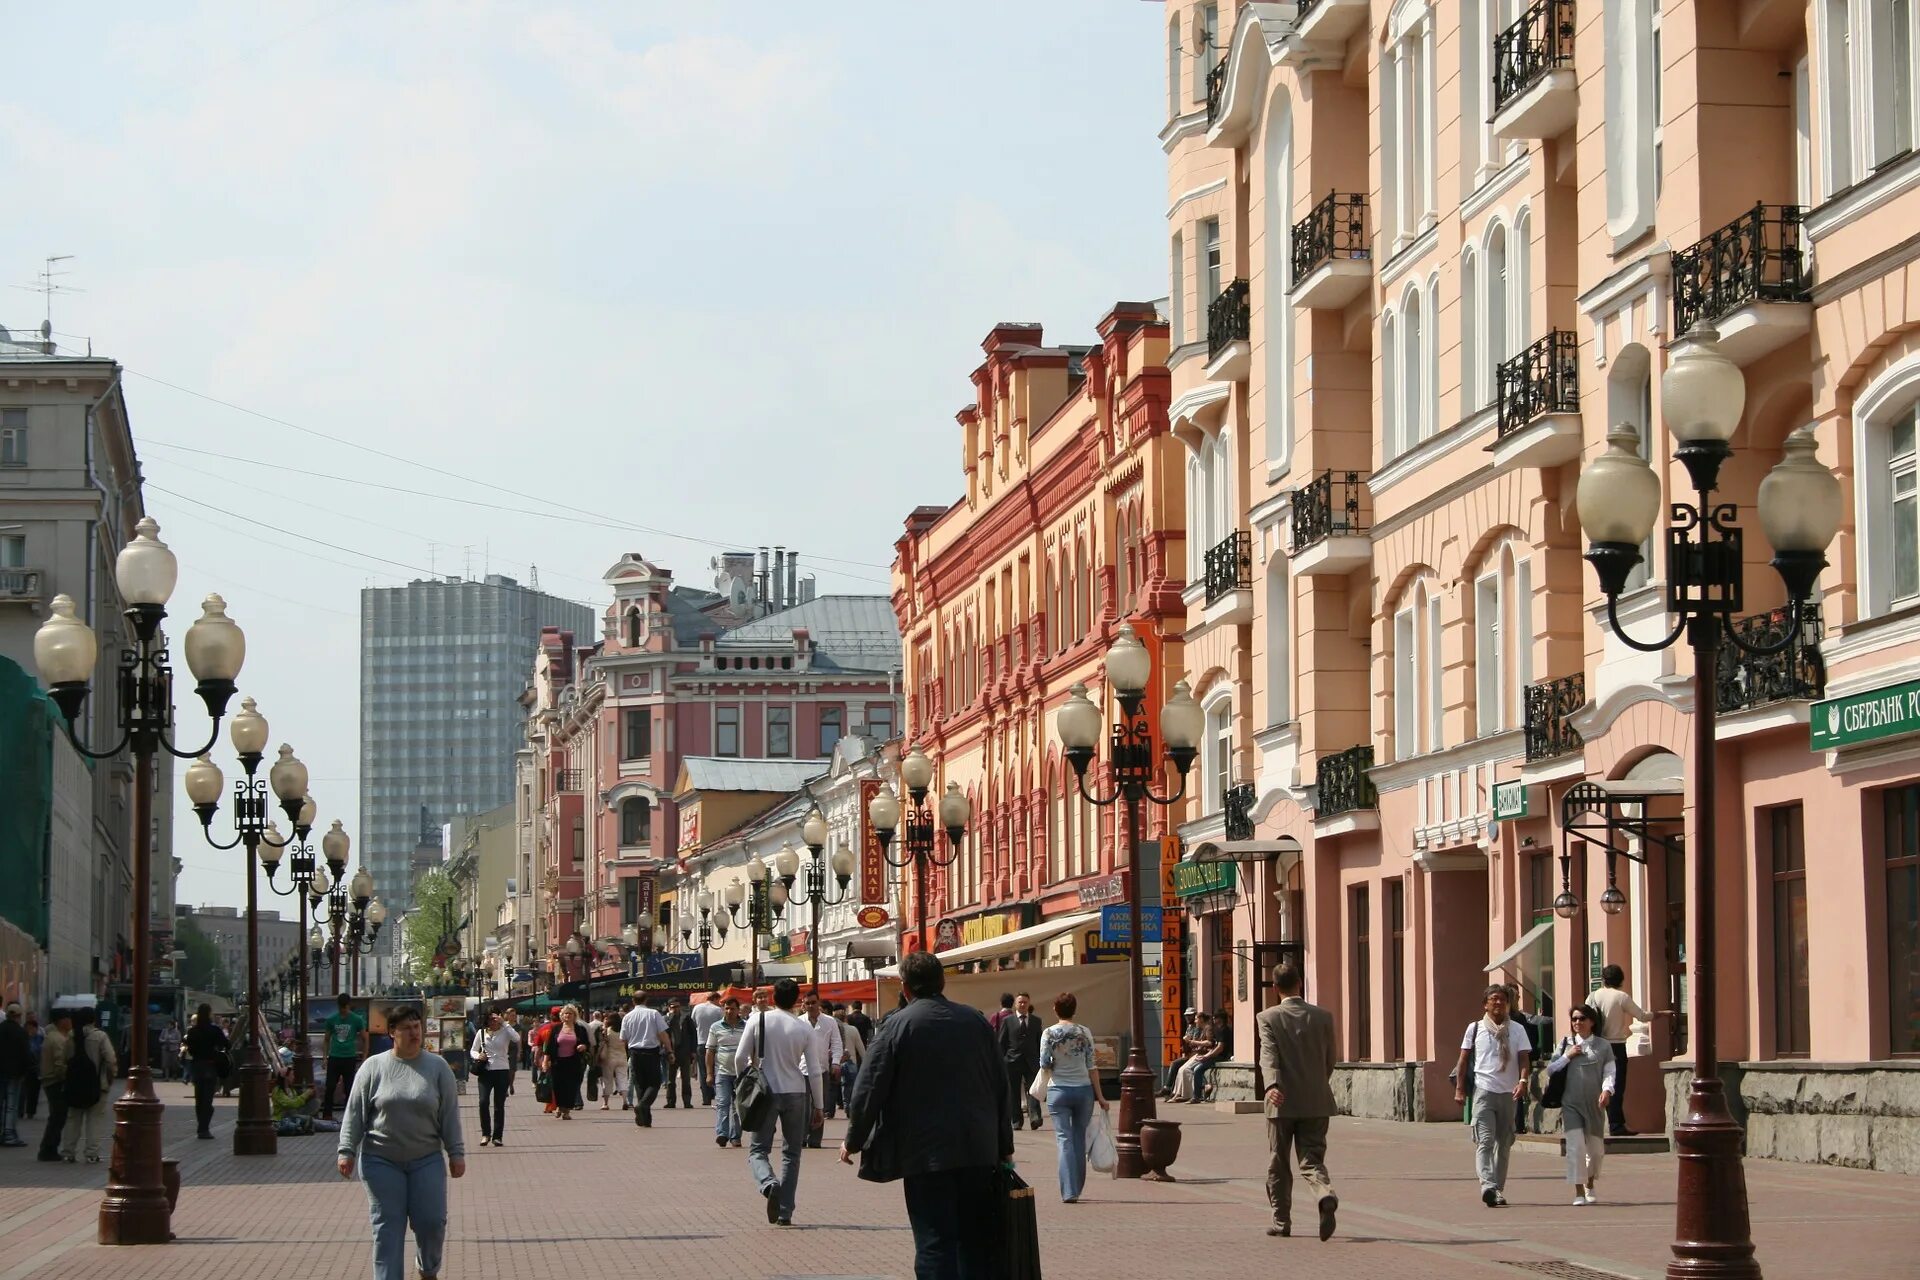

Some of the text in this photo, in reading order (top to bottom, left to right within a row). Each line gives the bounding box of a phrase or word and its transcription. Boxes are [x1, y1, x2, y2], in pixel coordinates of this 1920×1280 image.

[1844, 694, 1904, 732] СБЕРБАНК
[867, 790, 879, 895] АКВАРИАТ
[1109, 912, 1157, 921] АКВИУ-
[1109, 922, 1158, 931] МИСКА
